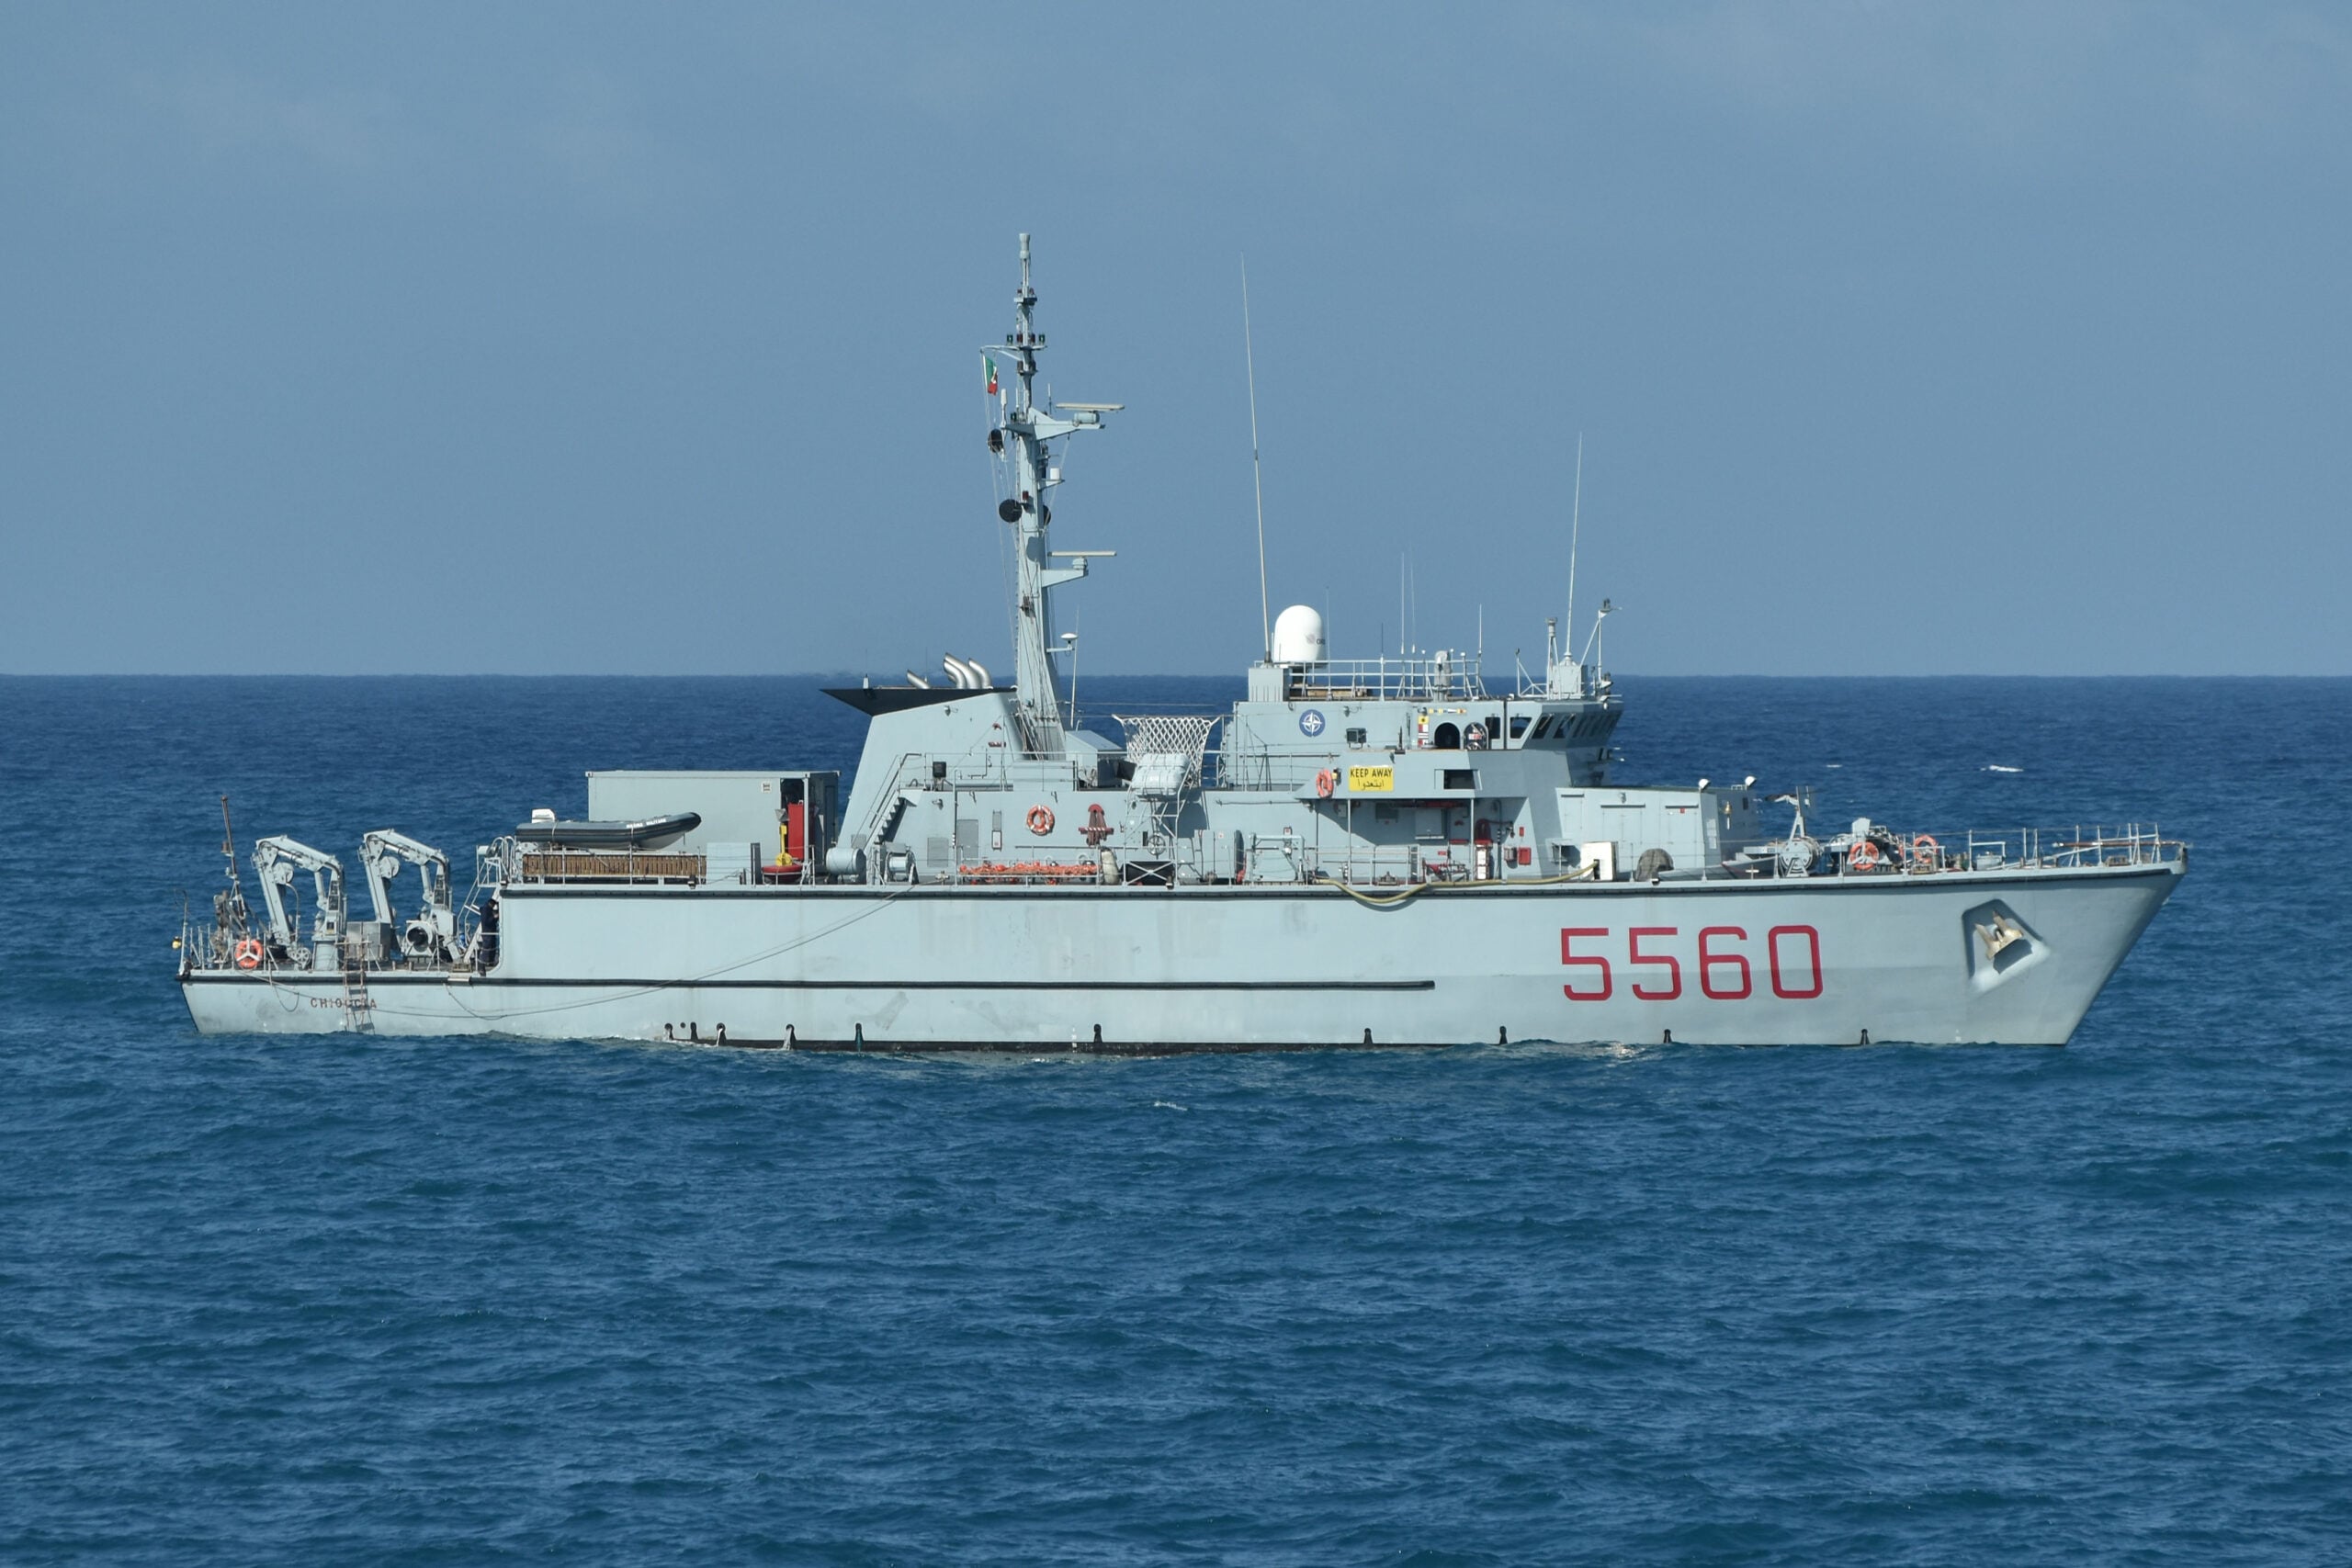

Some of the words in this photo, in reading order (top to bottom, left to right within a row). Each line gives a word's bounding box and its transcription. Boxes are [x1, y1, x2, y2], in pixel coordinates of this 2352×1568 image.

[1351, 768, 1369, 778] KEEP
[1372, 768, 1393, 778] AWAY
[1561, 925, 1824, 1001] 5560
